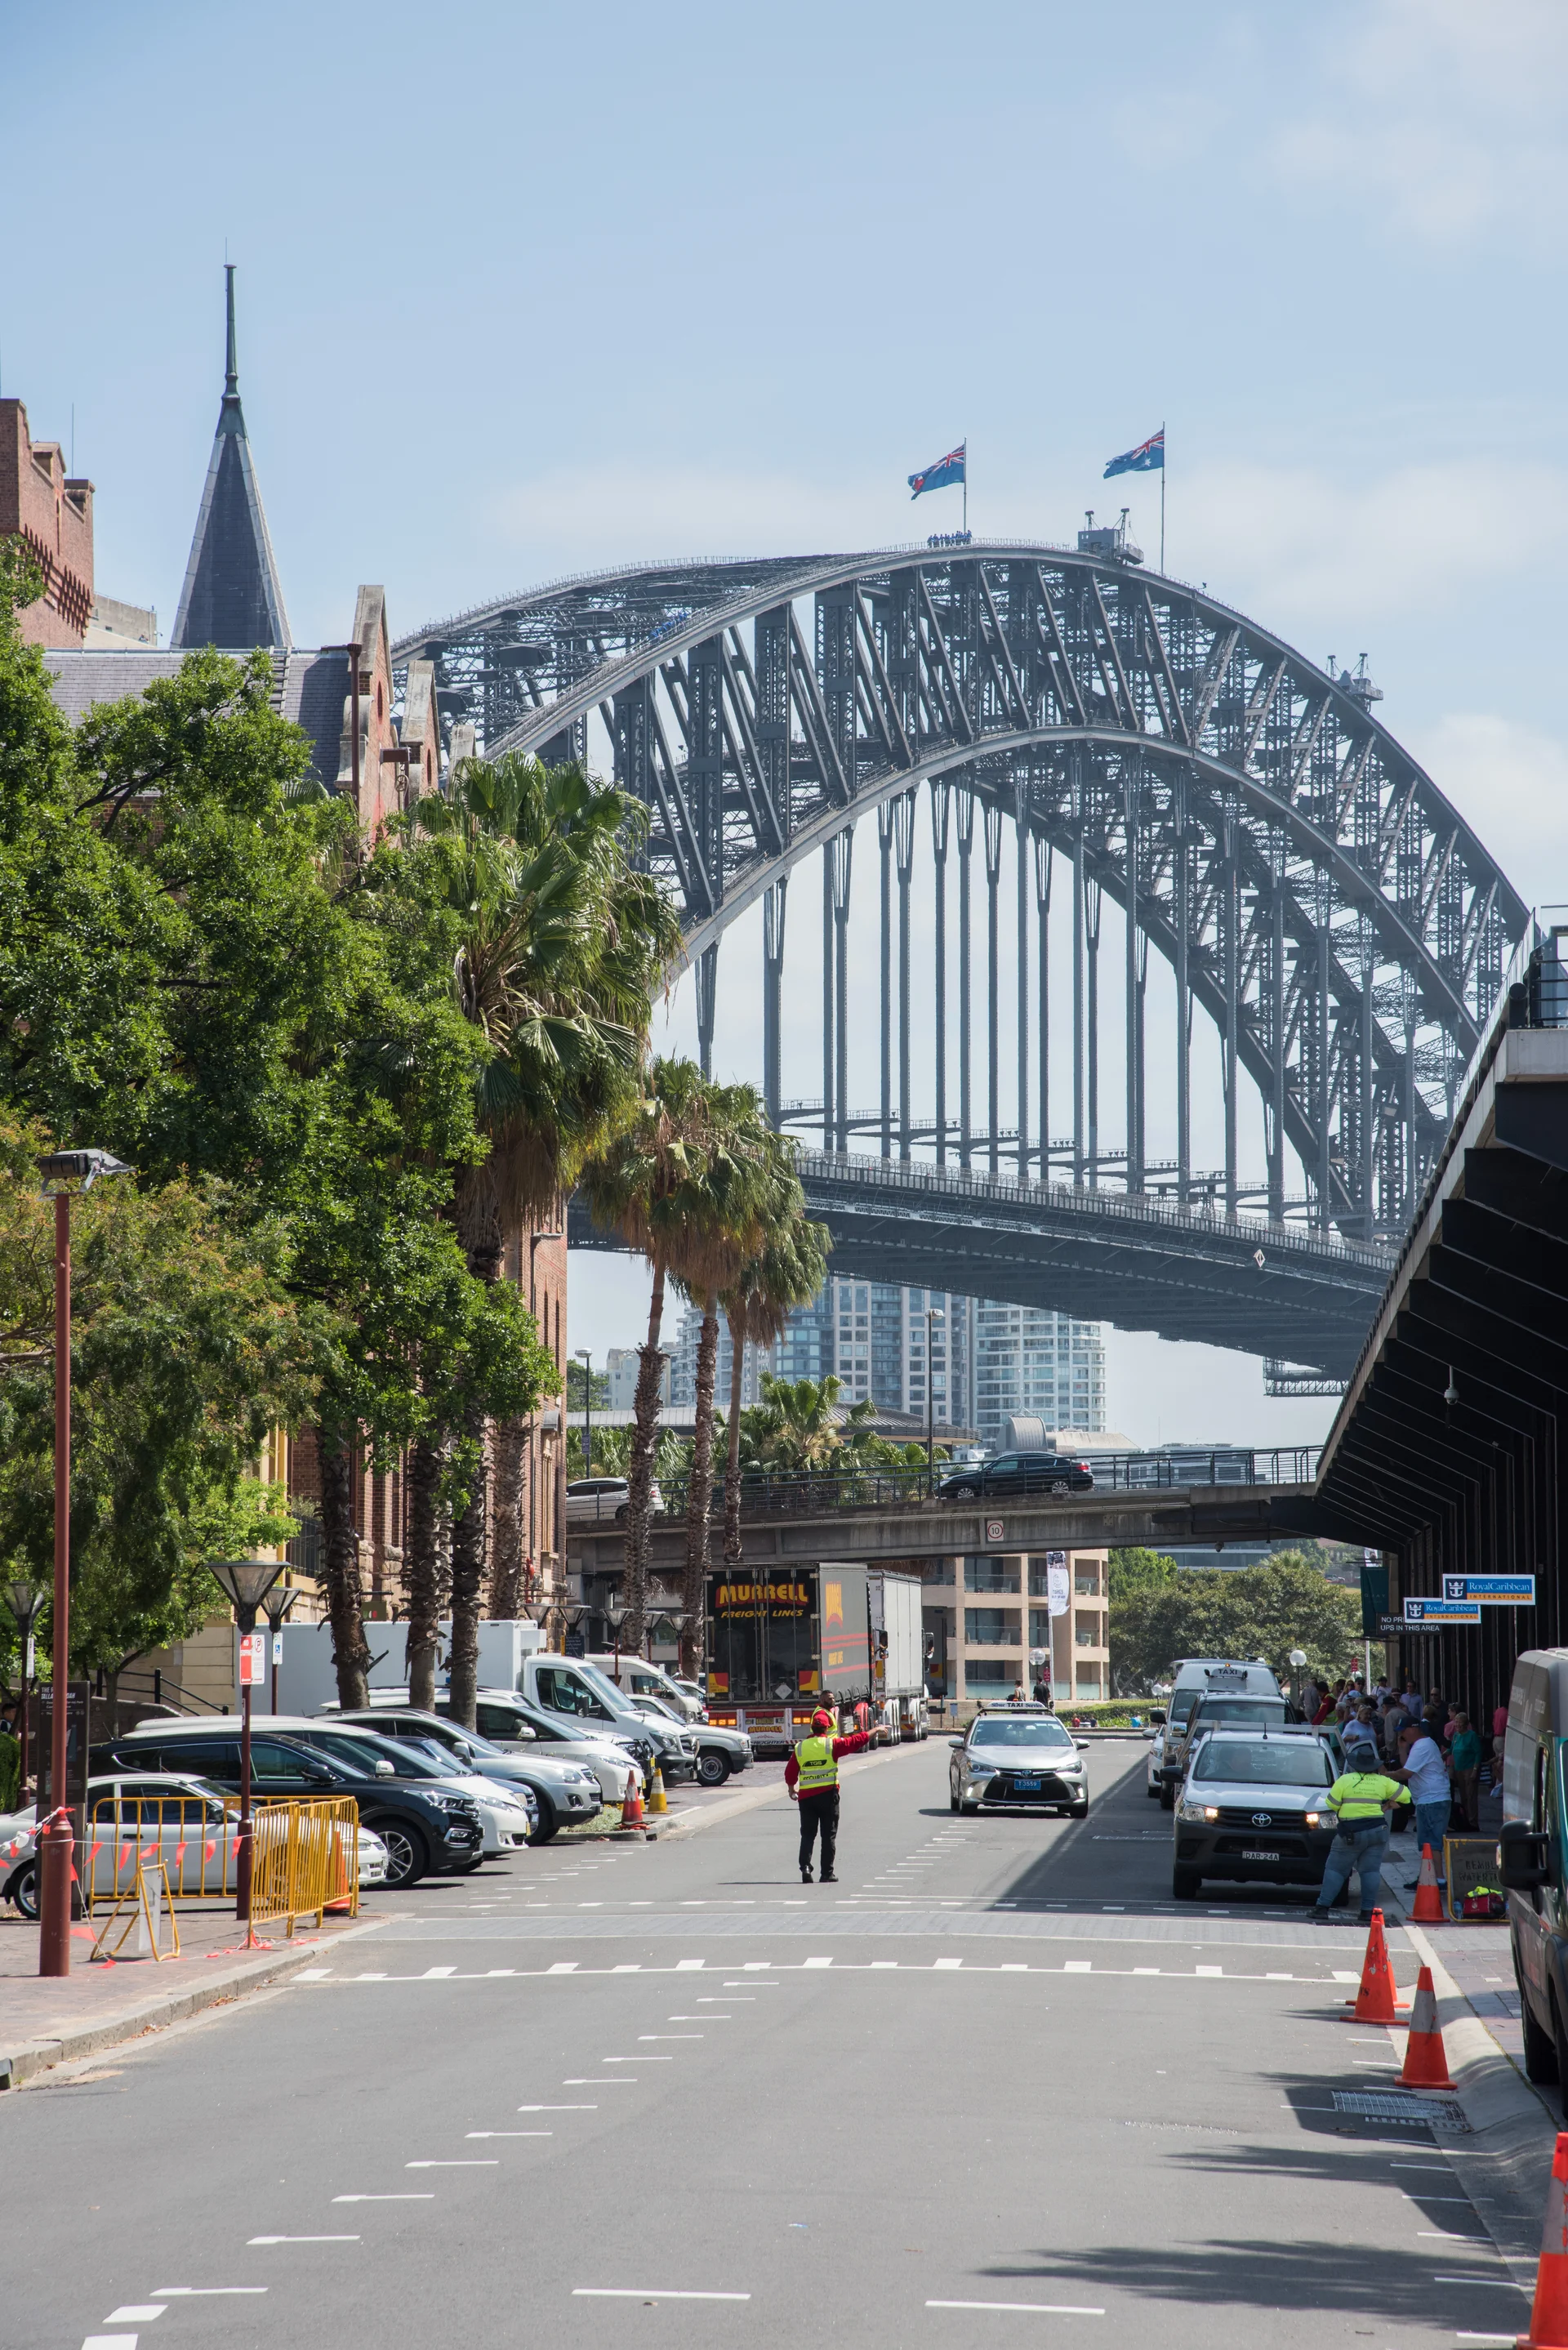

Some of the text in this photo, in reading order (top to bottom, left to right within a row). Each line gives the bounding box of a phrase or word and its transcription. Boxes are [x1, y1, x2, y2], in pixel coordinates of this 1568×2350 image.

[991, 1527, 1000, 1535] 10
[718, 1584, 808, 1607] MURRELL
[721, 1610, 767, 1618] FREIGHT
[748, 1725, 783, 1733] MURRELL
